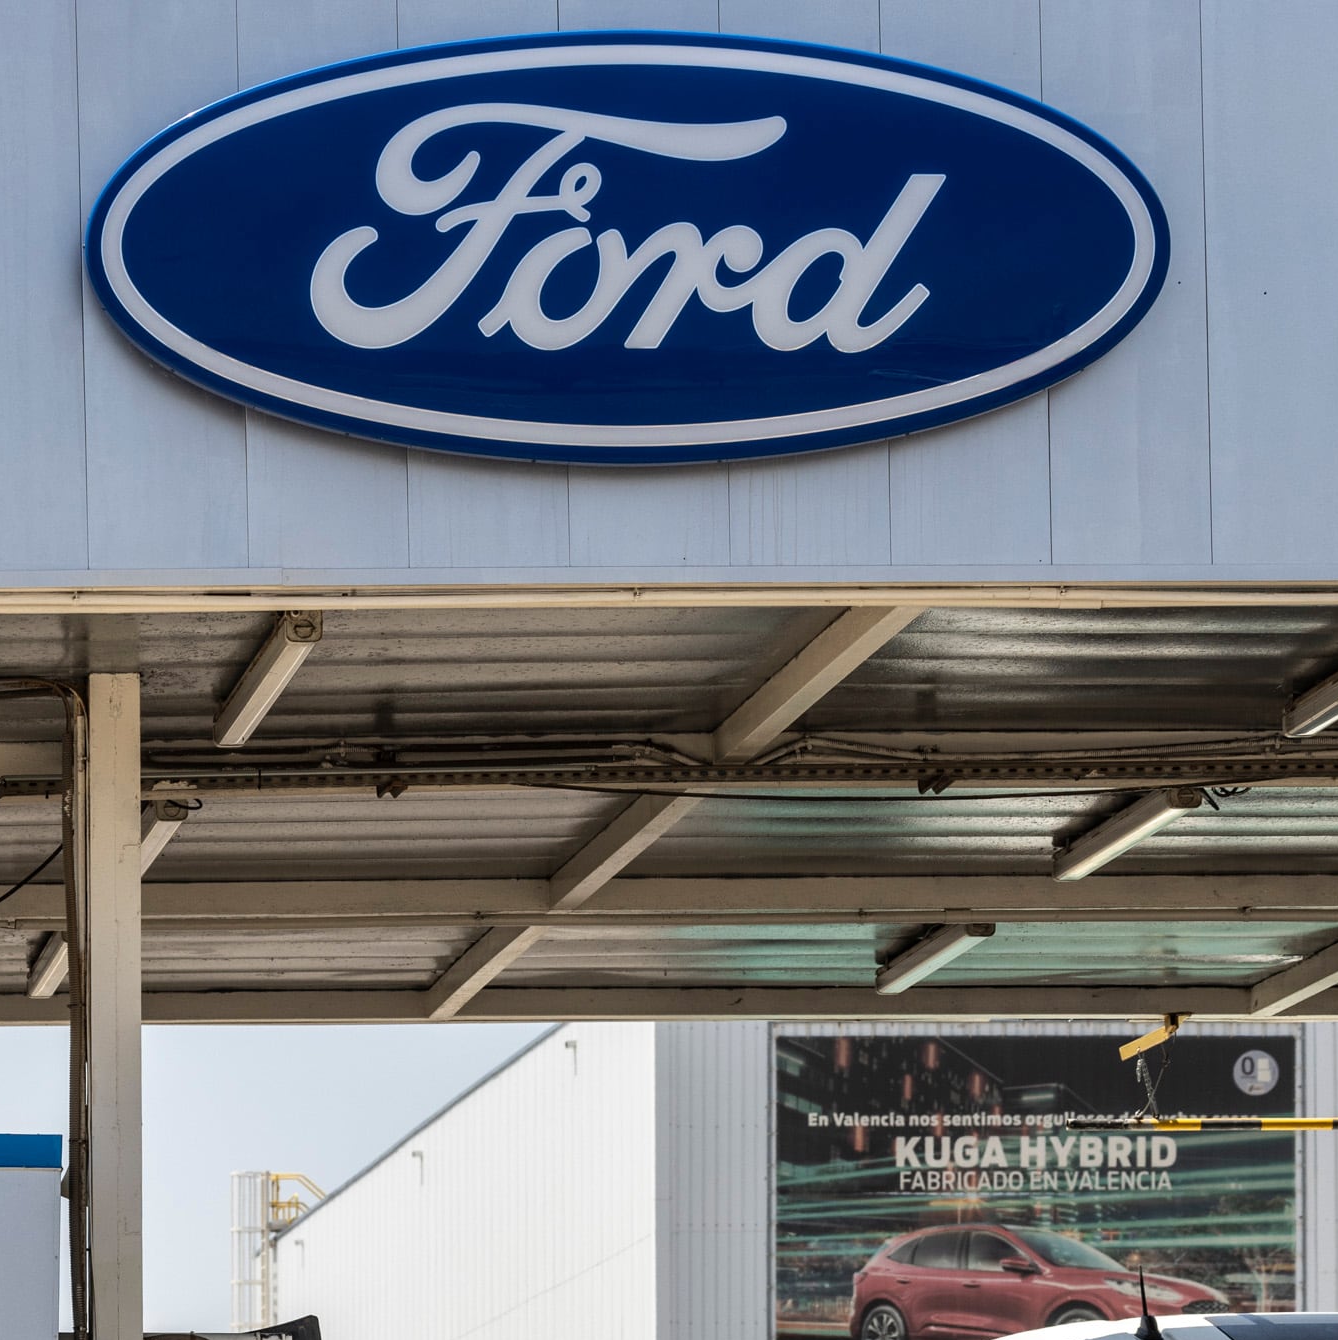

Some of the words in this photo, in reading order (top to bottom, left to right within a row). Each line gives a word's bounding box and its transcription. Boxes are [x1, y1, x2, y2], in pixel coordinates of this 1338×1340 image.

[311, 103, 946, 353] Ford
[808, 1112, 829, 1126] En
[833, 1112, 905, 1127] Valencia
[910, 1113, 938, 1127] nos
[943, 1112, 1021, 1127] sentimos
[895, 1136, 1008, 1168] KUGA
[1020, 1136, 1177, 1168] HYBRID
[899, 1171, 1024, 1191] FABRICADO
[1029, 1171, 1059, 1191] EN
[1064, 1171, 1172, 1191] VALENCIA
